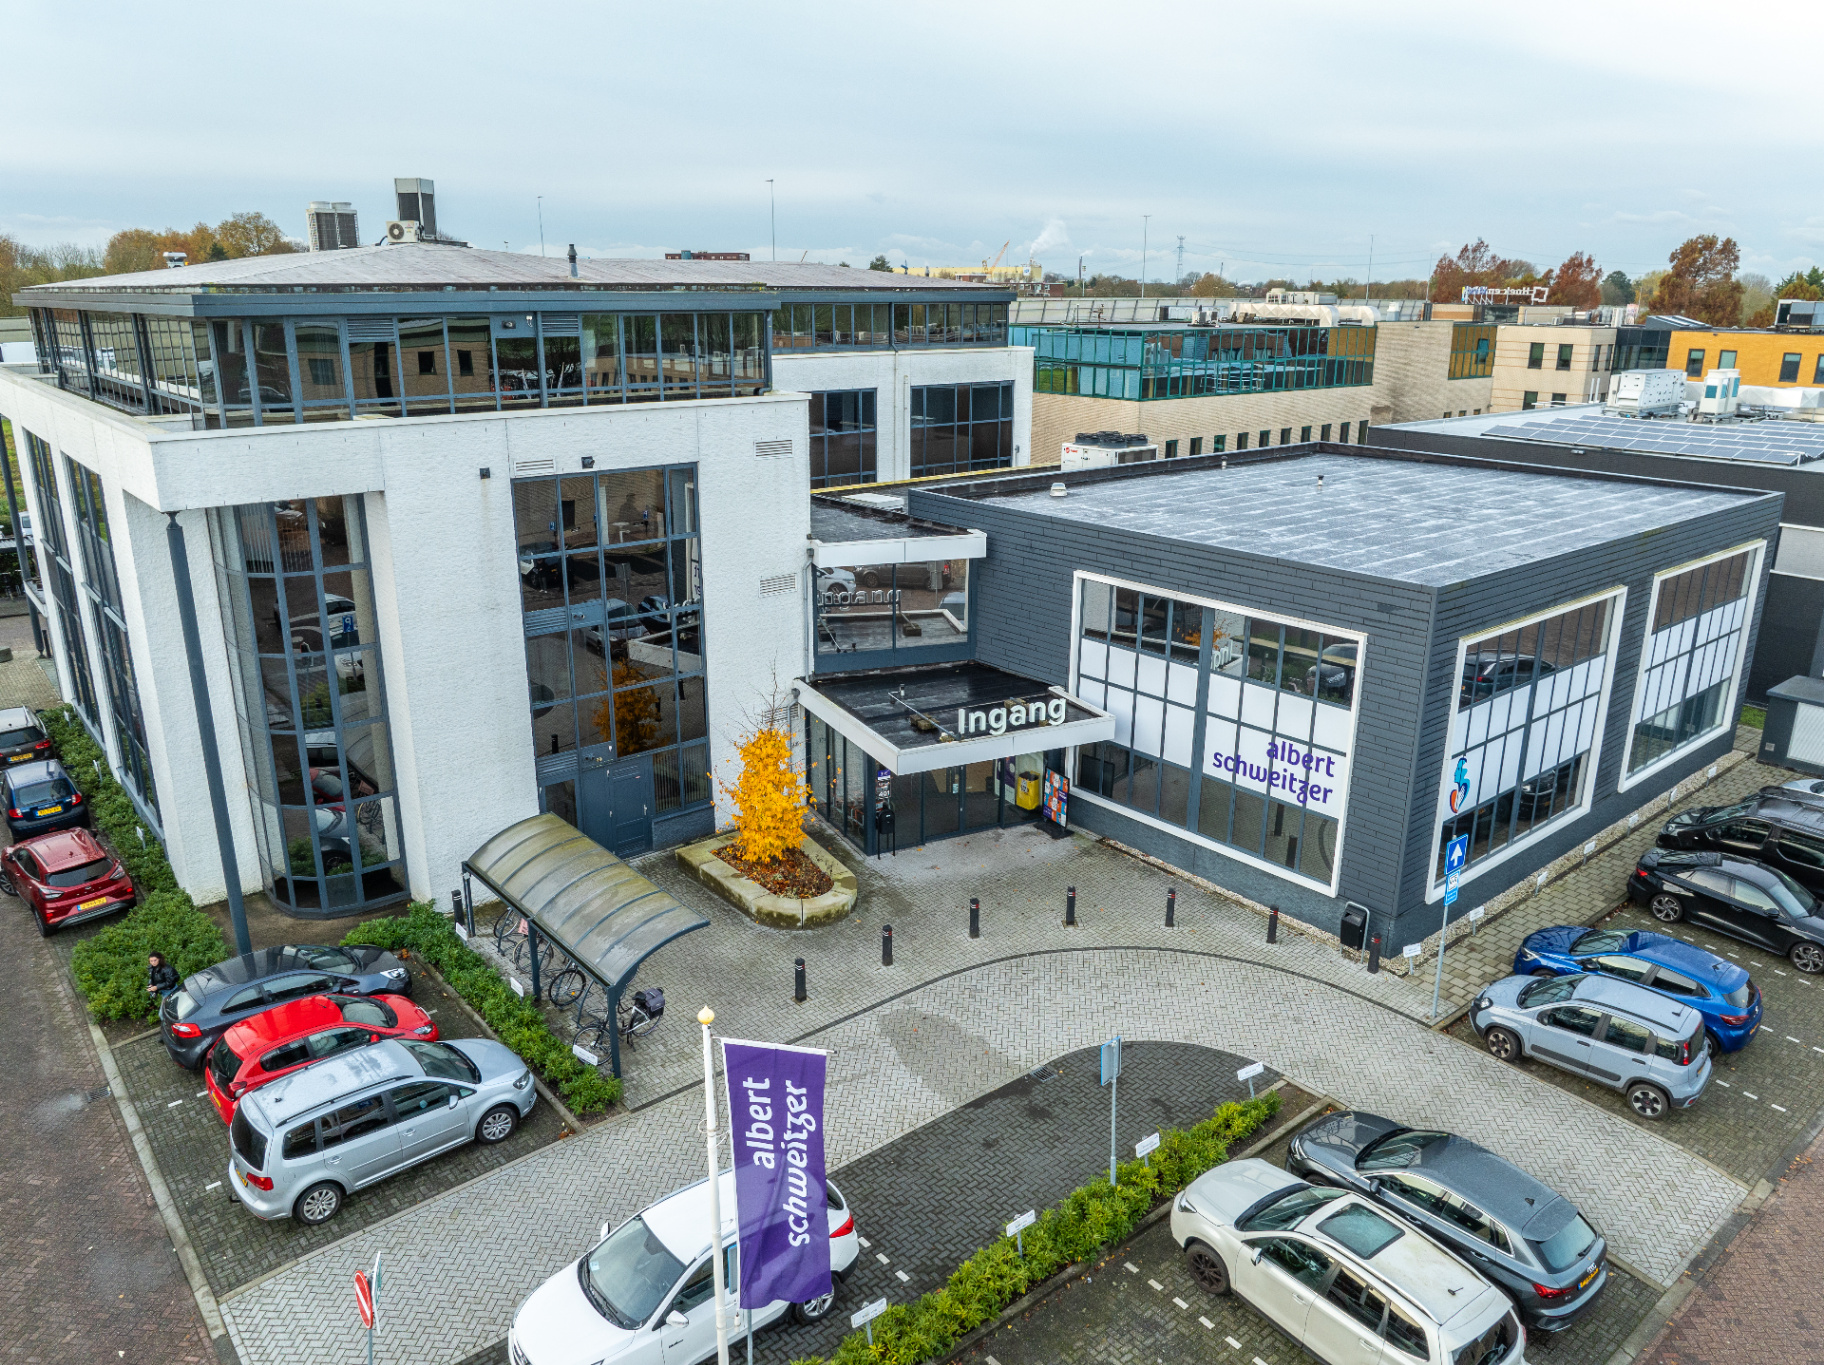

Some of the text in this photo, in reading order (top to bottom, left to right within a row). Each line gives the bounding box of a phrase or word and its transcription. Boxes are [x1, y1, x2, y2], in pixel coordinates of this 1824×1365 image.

[958, 697, 1067, 735] Ingang
[1212, 751, 1333, 804] schweitzer
[1266, 741, 1336, 778] albert
[742, 1076, 775, 1169] albert
[780, 1079, 817, 1247] schweitzer
